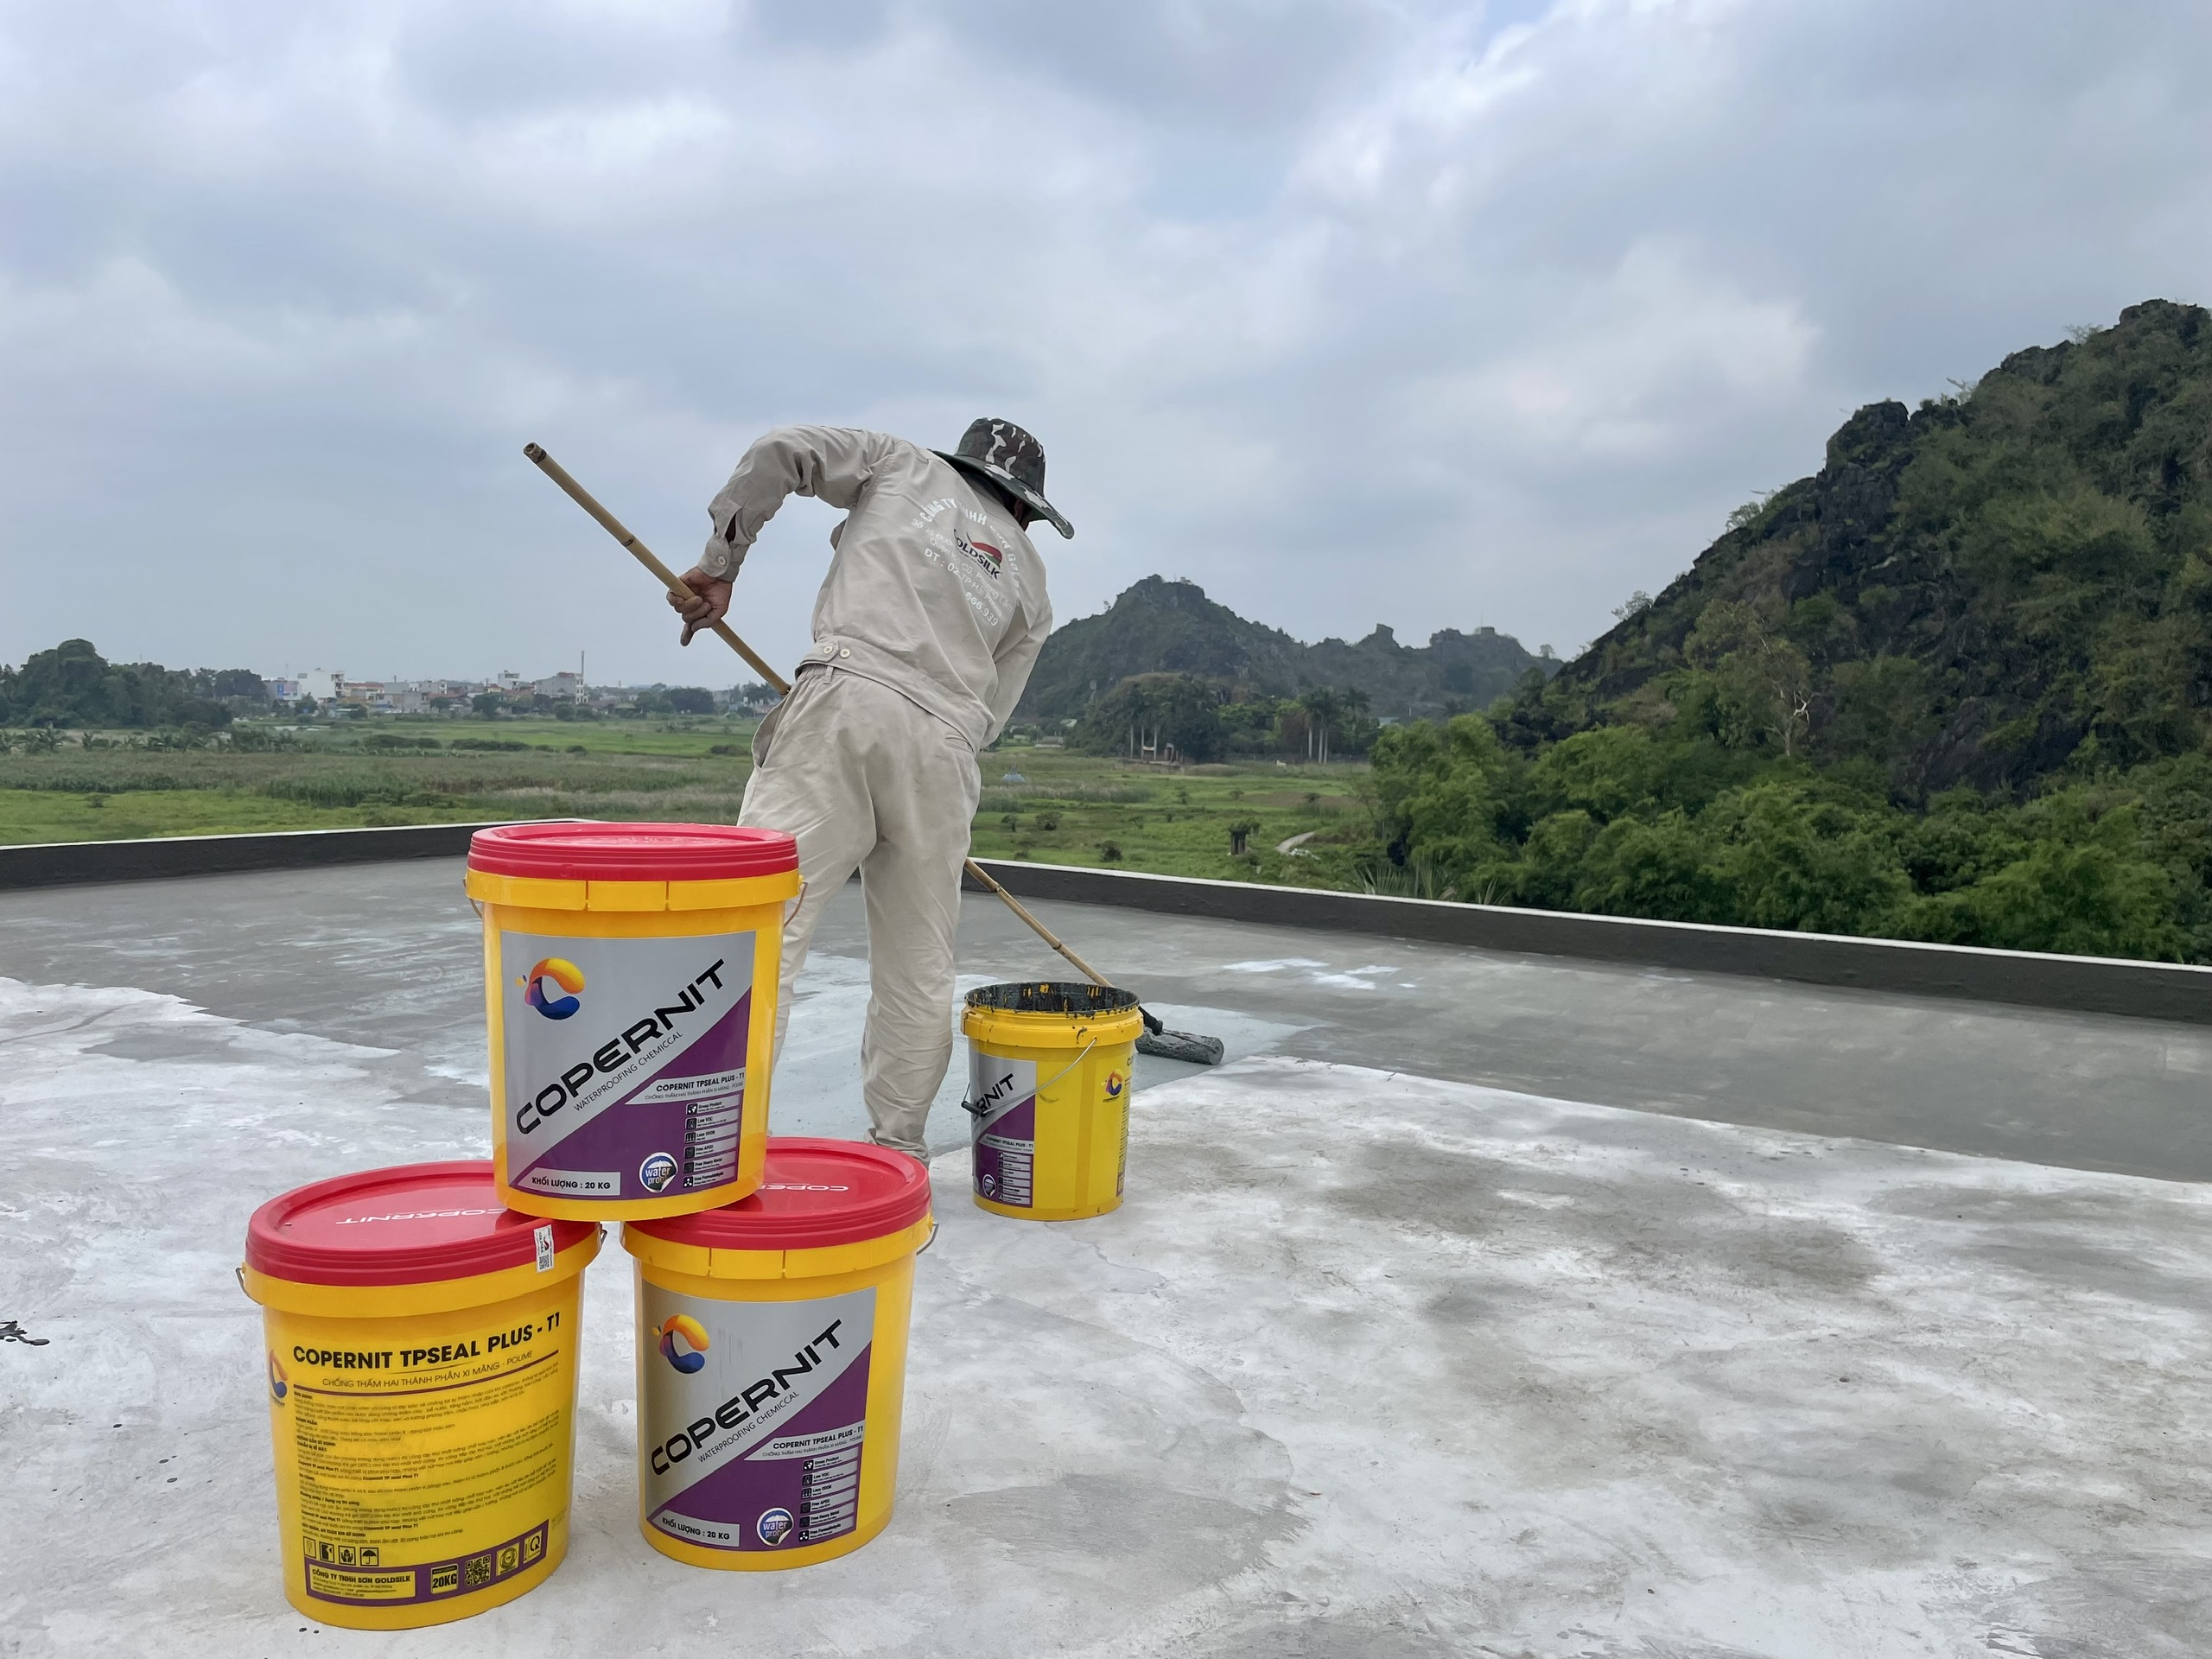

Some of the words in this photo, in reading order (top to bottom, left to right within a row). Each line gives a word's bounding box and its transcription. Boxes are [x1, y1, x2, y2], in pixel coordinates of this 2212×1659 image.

[516, 958, 725, 1135] COPERNIT
[574, 1064, 638, 1112] WATERPROOFING
[638, 1031, 683, 1066] CHEMICCAL
[657, 1082, 695, 1091] COPERNIT
[696, 1077, 720, 1088] TPSEAL
[721, 1074, 735, 1084] PLUS
[645, 1166, 671, 1177] water
[531, 1176, 550, 1185] KHỐI
[551, 1179, 578, 1189] LƯỢNG
[294, 1345, 393, 1369] COPERNIT
[400, 1340, 480, 1367] TPSEAL
[487, 1324, 533, 1353] PLUS
[547, 1312, 561, 1332] T1
[322, 1376, 354, 1388] CHỐNG
[357, 1376, 382, 1388] THẤM
[383, 1377, 400, 1387] HAI
[401, 1374, 433, 1386] THÀNH
[435, 1368, 461, 1382] PHẦN
[462, 1366, 471, 1376] XI
[473, 1360, 500, 1376] MĂNG
[650, 1319, 842, 1476] COPERNIT
[697, 1423, 757, 1463] WATERPROOFING
[756, 1390, 800, 1428] CHEMICCAL
[773, 1440, 811, 1450] COPERNIT
[812, 1434, 836, 1445] TPSEAL
[837, 1429, 853, 1440] PLUS
[662, 1516, 677, 1529] KHỐI
[677, 1522, 701, 1535] LƯỢNG
[763, 1521, 787, 1531] water
[375, 1575, 411, 1584] GOLDSILK
[433, 1573, 457, 1589] 20KG
